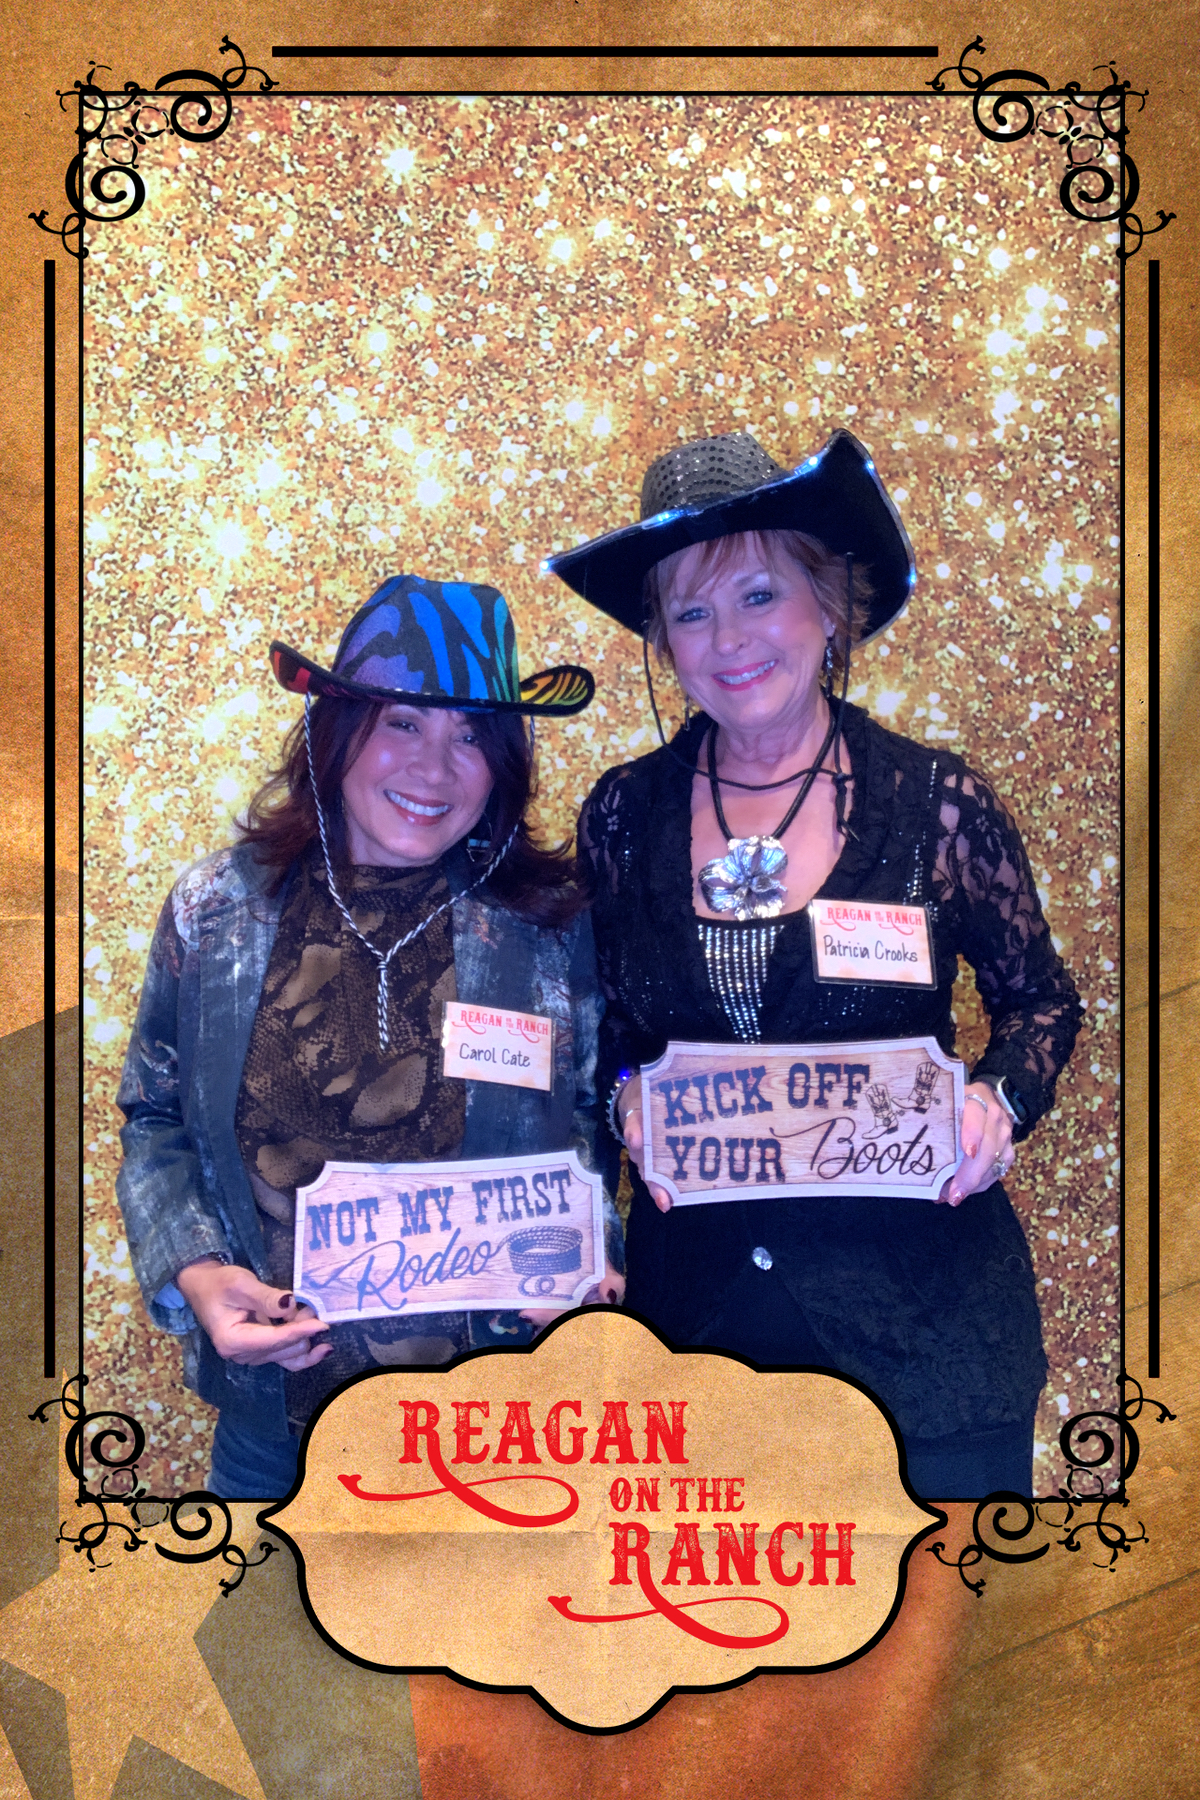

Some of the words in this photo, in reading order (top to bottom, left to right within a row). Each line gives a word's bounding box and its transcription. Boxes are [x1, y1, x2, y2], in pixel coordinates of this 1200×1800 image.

[820, 907, 871, 931] REAGAN
[878, 911, 922, 935] RANCH
[823, 934, 870, 959] Patricia
[874, 940, 918, 962] Crooks
[451, 1010, 502, 1035] REAGAN
[507, 1018, 549, 1044] RANCH
[459, 1042, 497, 1063] Carol
[501, 1048, 531, 1067] Cate
[658, 1065, 773, 1128] KICK
[787, 1062, 870, 1110] OFF
[665, 1135, 785, 1183] YOUR
[769, 1116, 936, 1180] Boots
[307, 1197, 379, 1250] NOT
[398, 1186, 454, 1237] MY
[471, 1169, 572, 1224] FIRST
[308, 1227, 504, 1311] Rodeo
